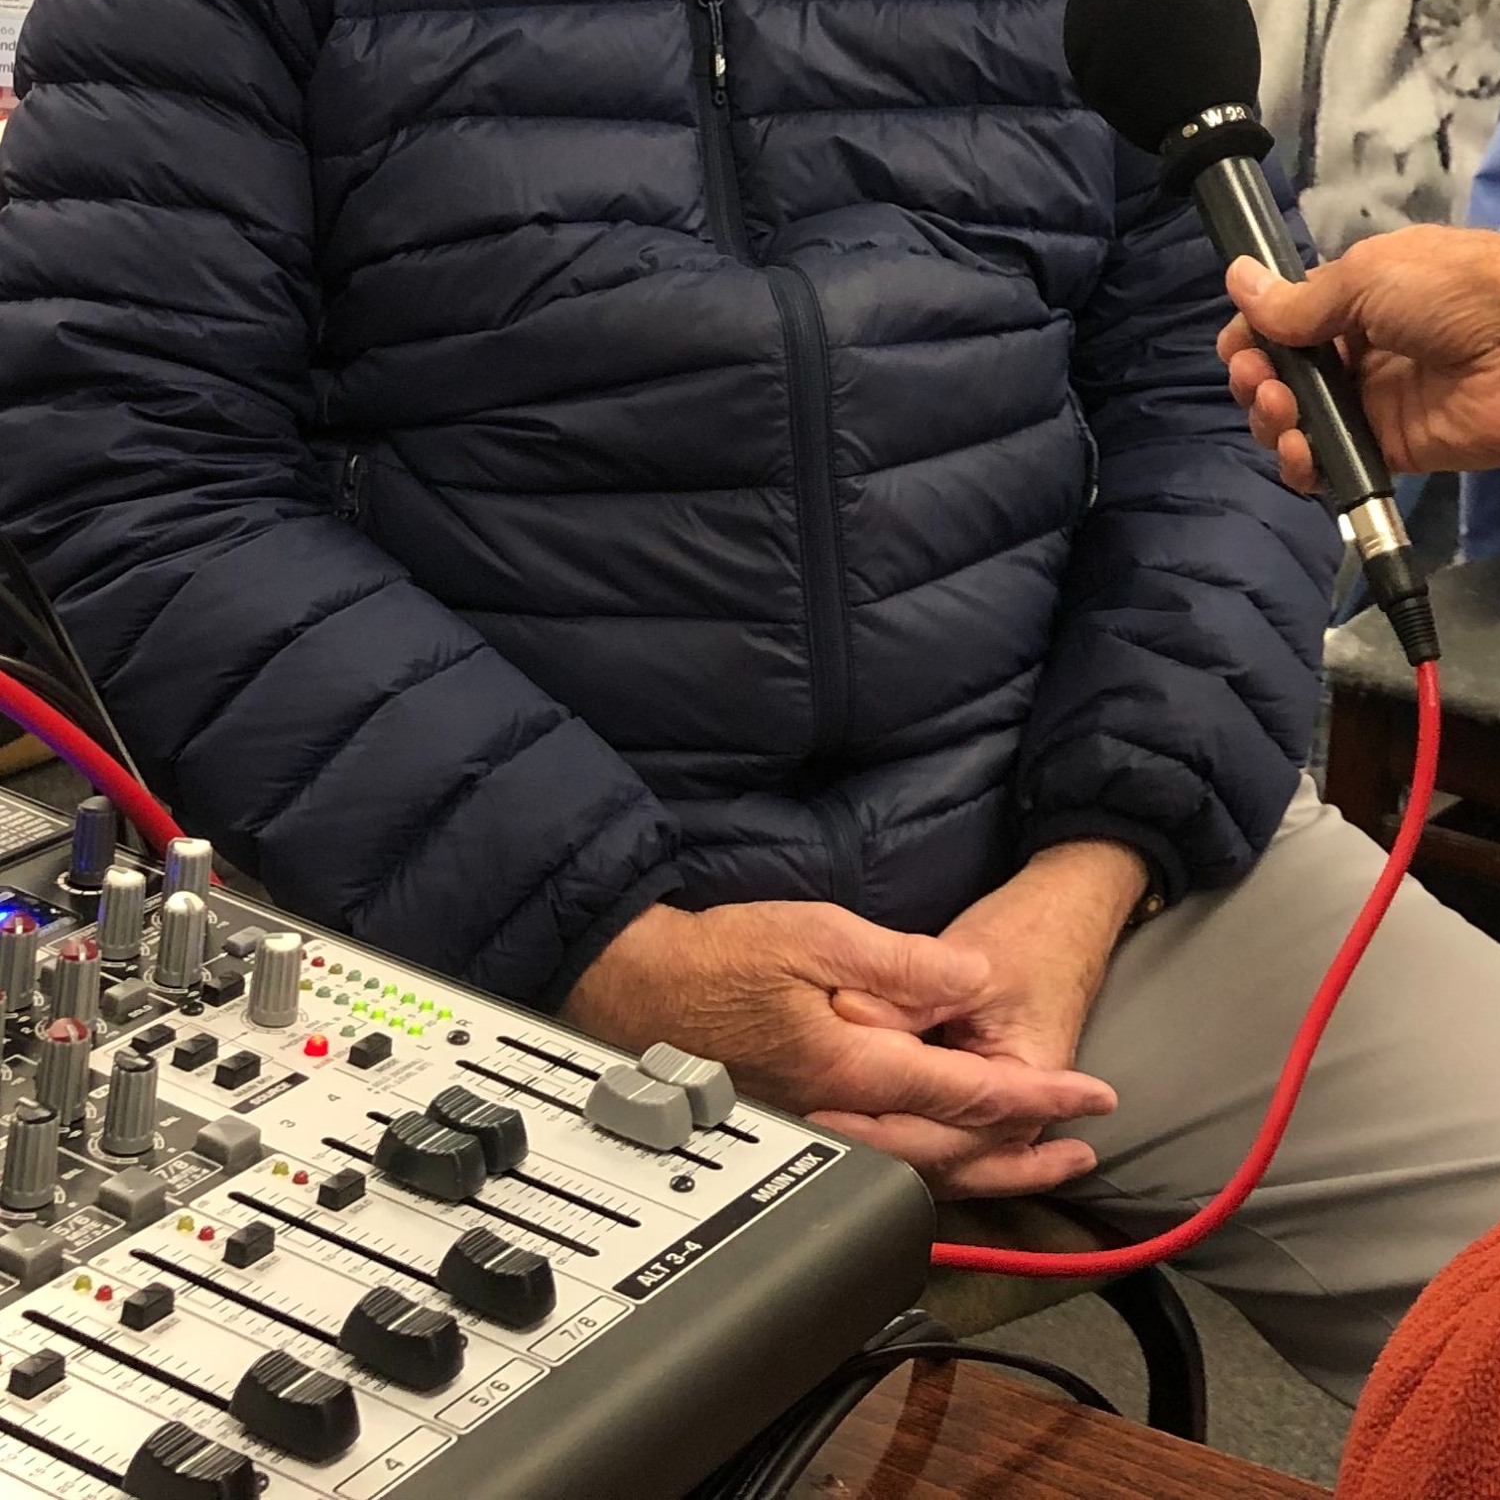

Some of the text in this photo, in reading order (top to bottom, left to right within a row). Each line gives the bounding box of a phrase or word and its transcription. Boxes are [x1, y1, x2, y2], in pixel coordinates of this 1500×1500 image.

[279, 1119, 296, 1128] 3
[155, 1160, 189, 1180] 7/8
[751, 1152, 824, 1204] MAIN MIX
[52, 1215, 90, 1237] 5/6
[636, 1239, 704, 1288] ALT 3-4
[558, 1315, 598, 1342] 7/8
[468, 1379, 511, 1408] 5/6
[384, 1457, 407, 1473] 4
